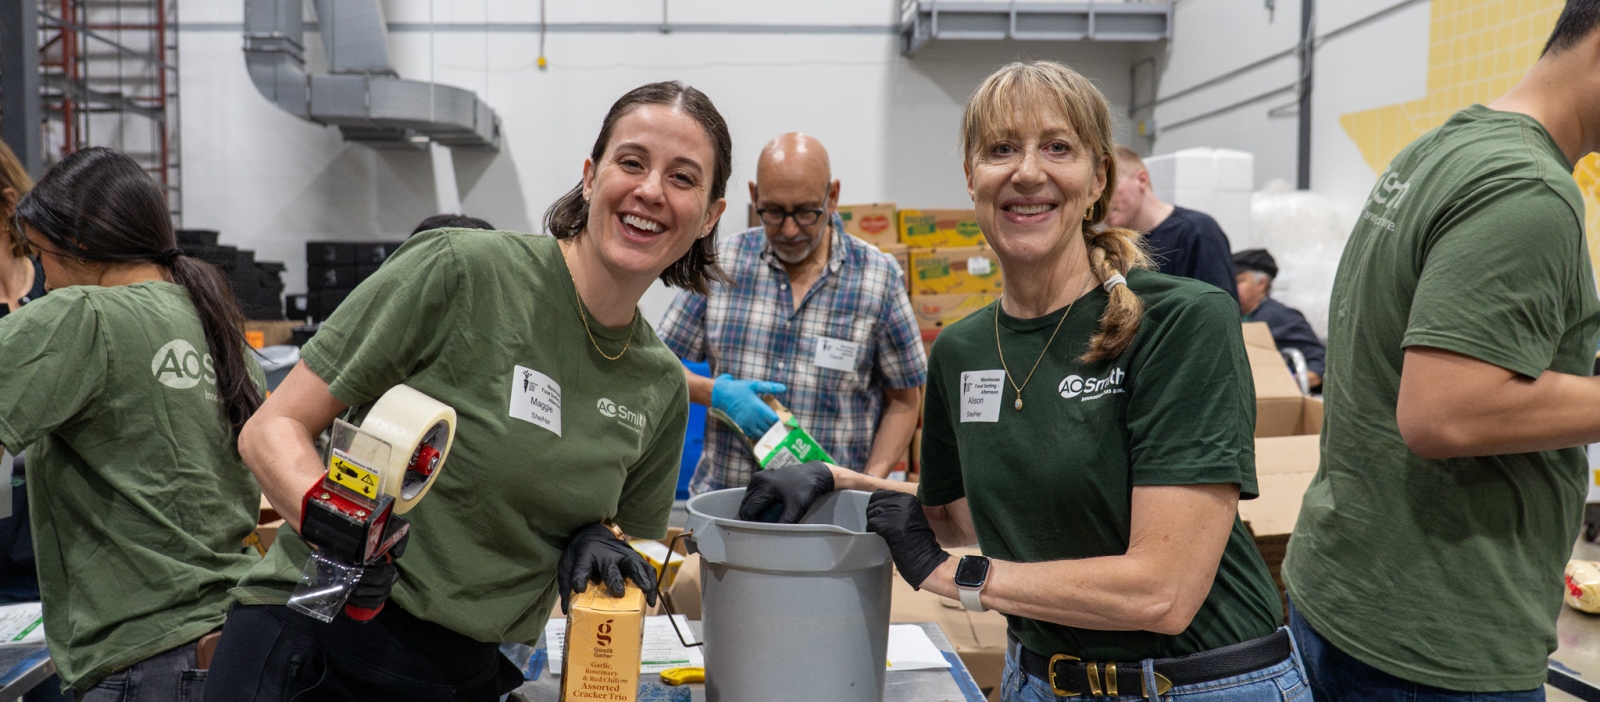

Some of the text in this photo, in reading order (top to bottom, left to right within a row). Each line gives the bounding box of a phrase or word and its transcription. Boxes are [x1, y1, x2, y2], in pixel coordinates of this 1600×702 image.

[531, 396, 554, 414] Maggie
[968, 396, 985, 405] Alison
[531, 412, 551, 425] She/Her
[590, 662, 613, 670] Garlic,
[585, 668, 618, 677] Rosemary
[589, 675, 603, 683] Red
[581, 683, 620, 692] Assorted
[573, 690, 627, 701] Cracker Trio
